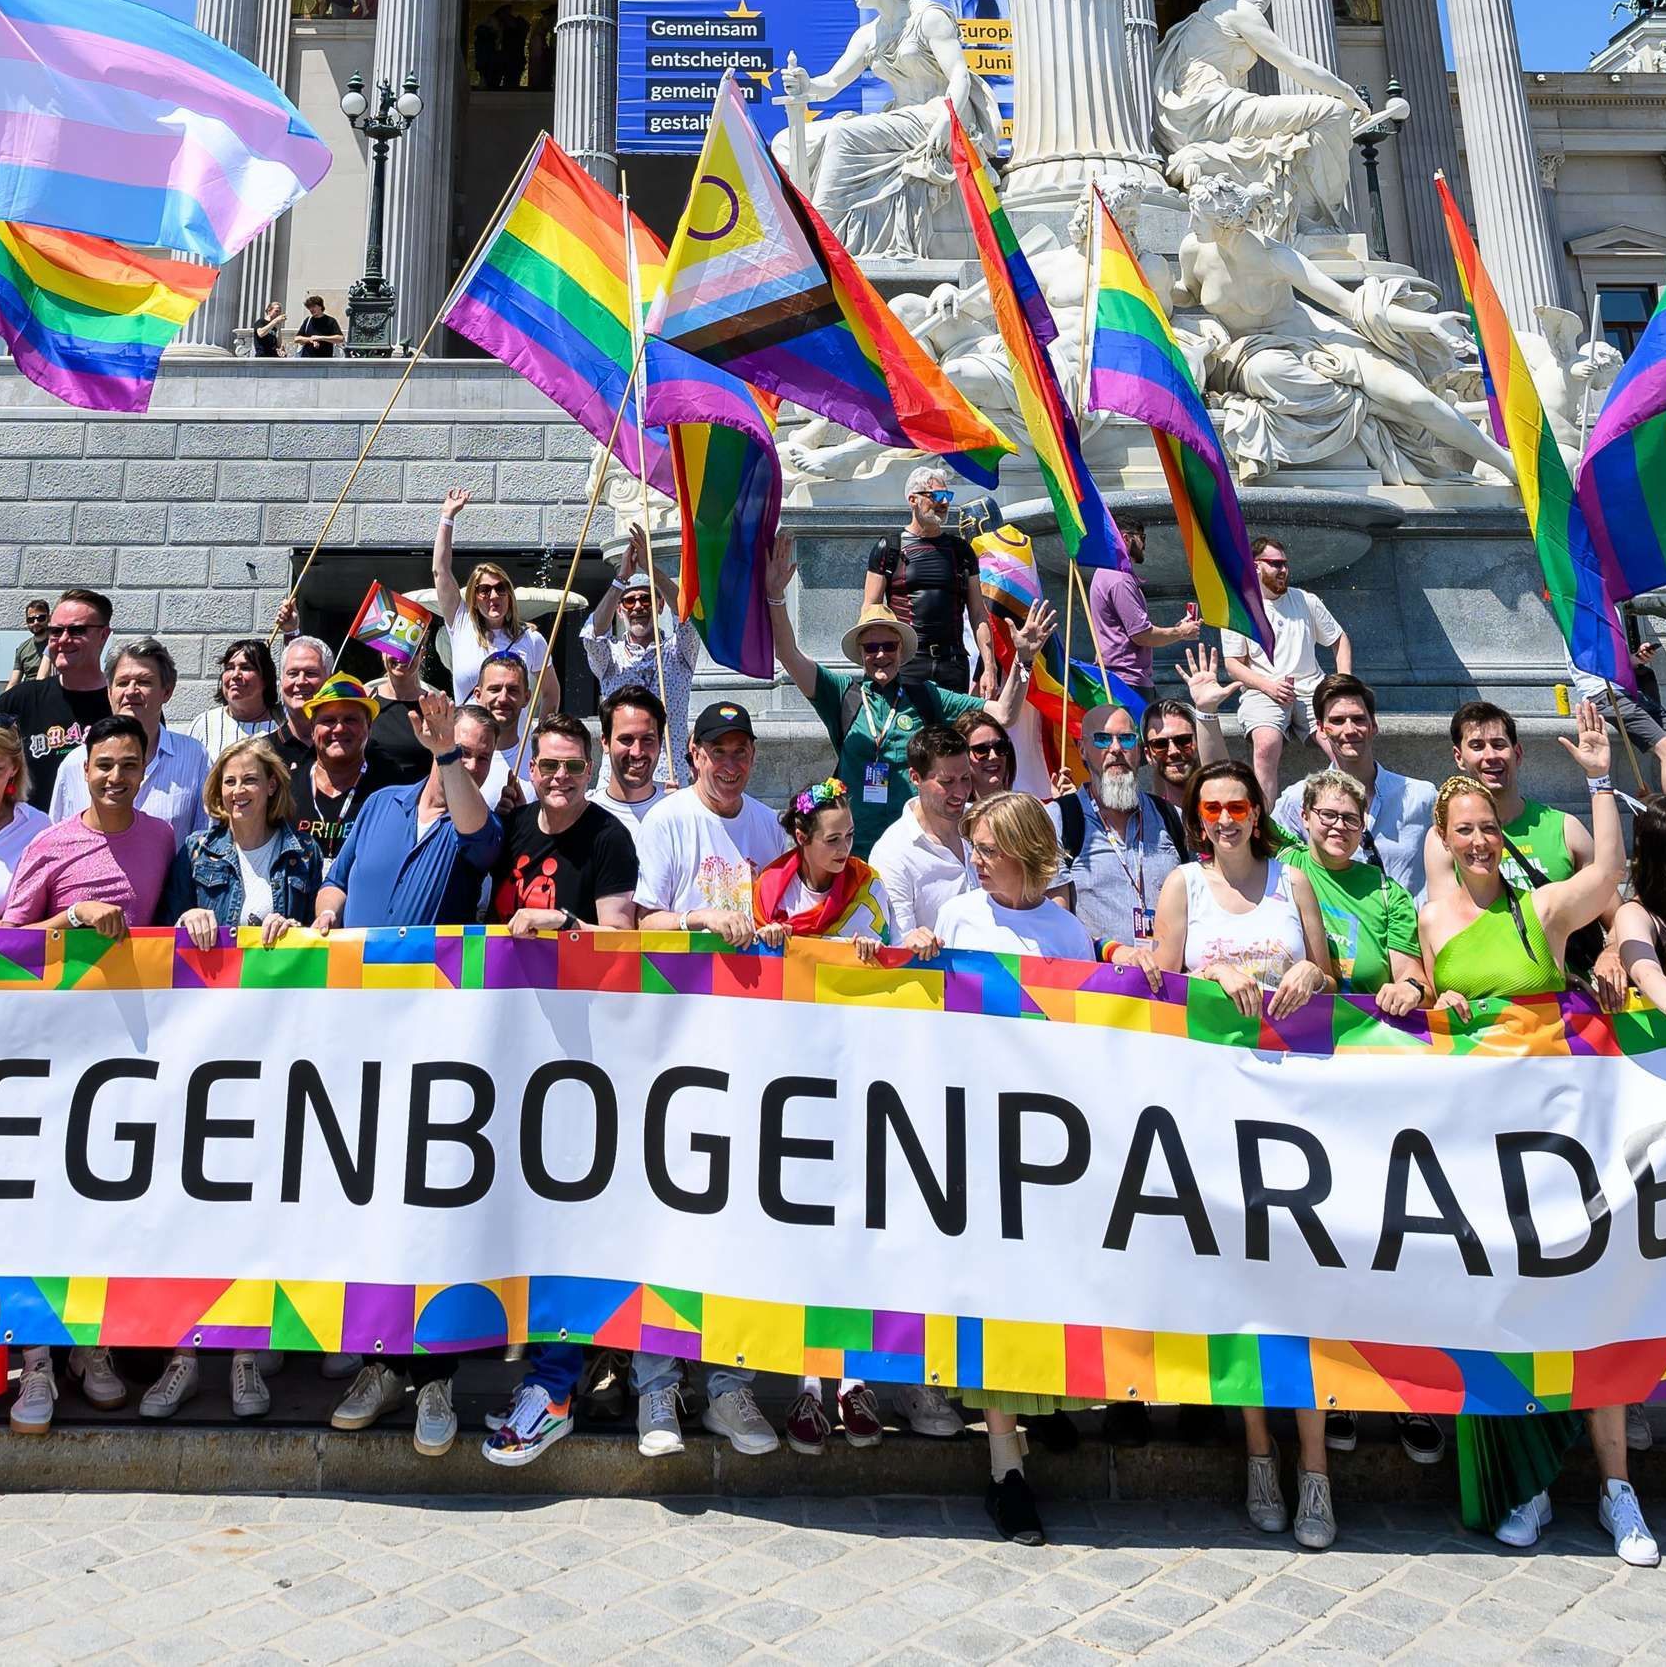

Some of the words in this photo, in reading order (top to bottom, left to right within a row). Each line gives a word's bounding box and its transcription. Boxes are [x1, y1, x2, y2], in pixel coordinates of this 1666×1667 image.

[651, 20, 758, 36] Gemeinsam
[651, 51, 767, 70] entscheiden,
[976, 54, 1012, 70] Juni
[650, 82, 754, 102] gemeinm
[650, 113, 713, 133] gestalt
[376, 609, 425, 647] SPÖ
[298, 819, 355, 839] PRIDE
